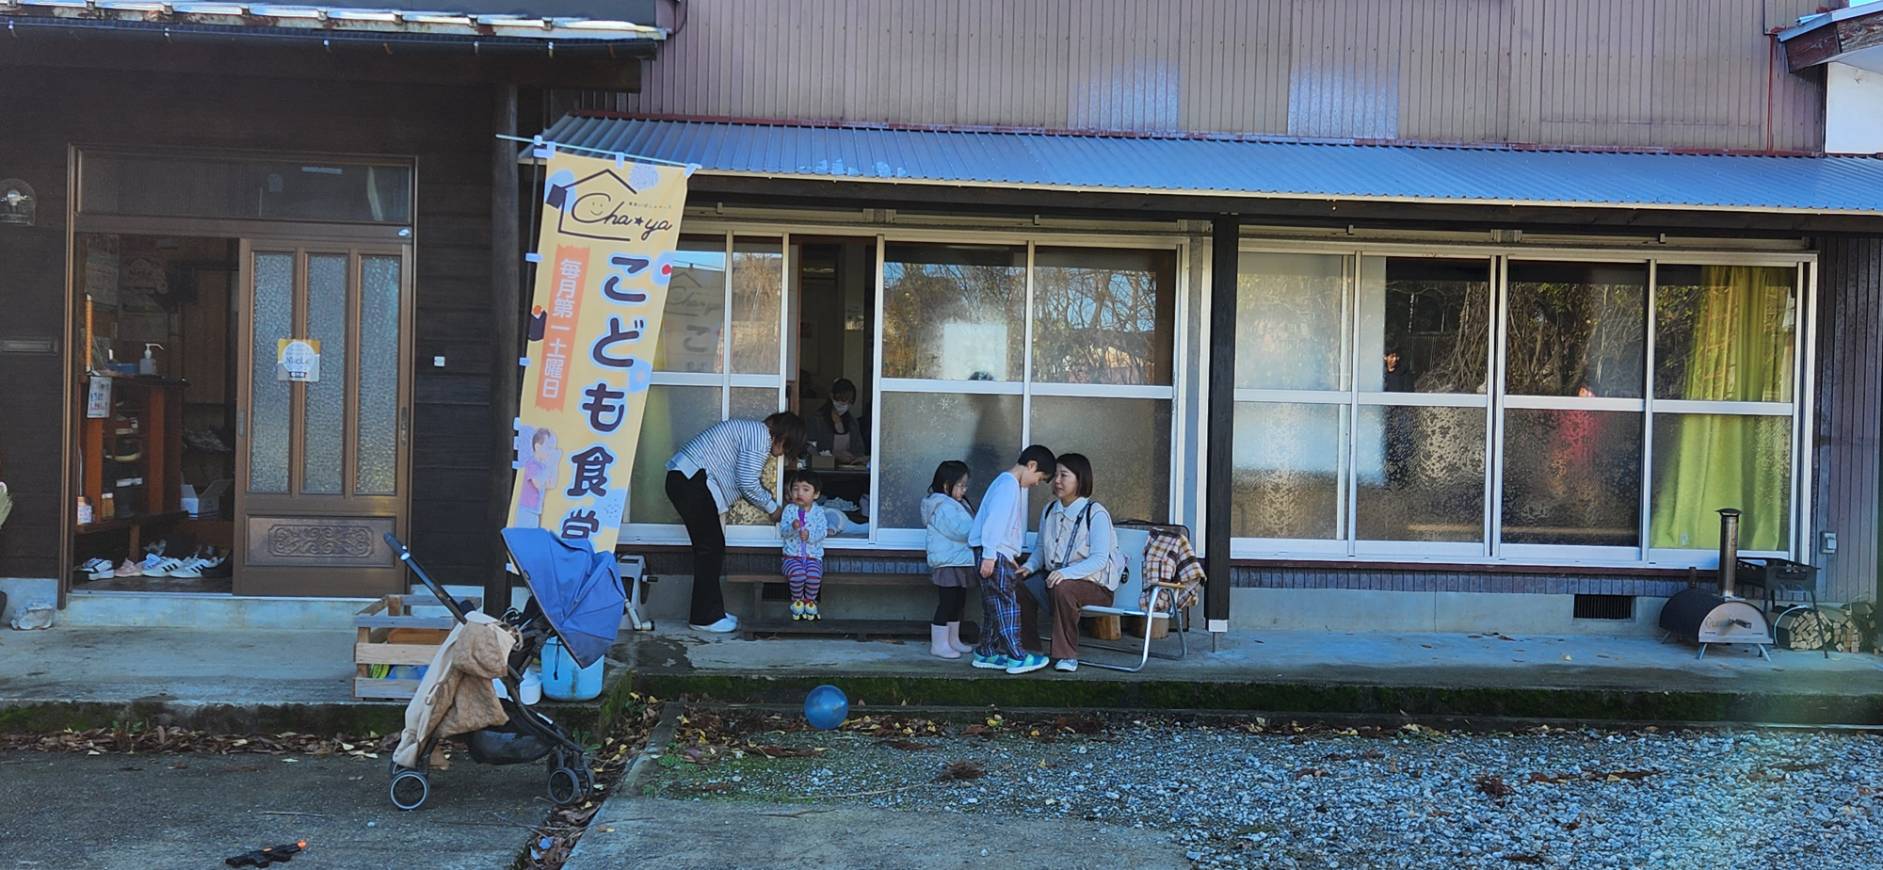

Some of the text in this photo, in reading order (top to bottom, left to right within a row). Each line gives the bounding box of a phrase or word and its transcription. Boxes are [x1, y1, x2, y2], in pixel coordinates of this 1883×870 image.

[542, 258, 582, 399] 毎月第一土曜日
